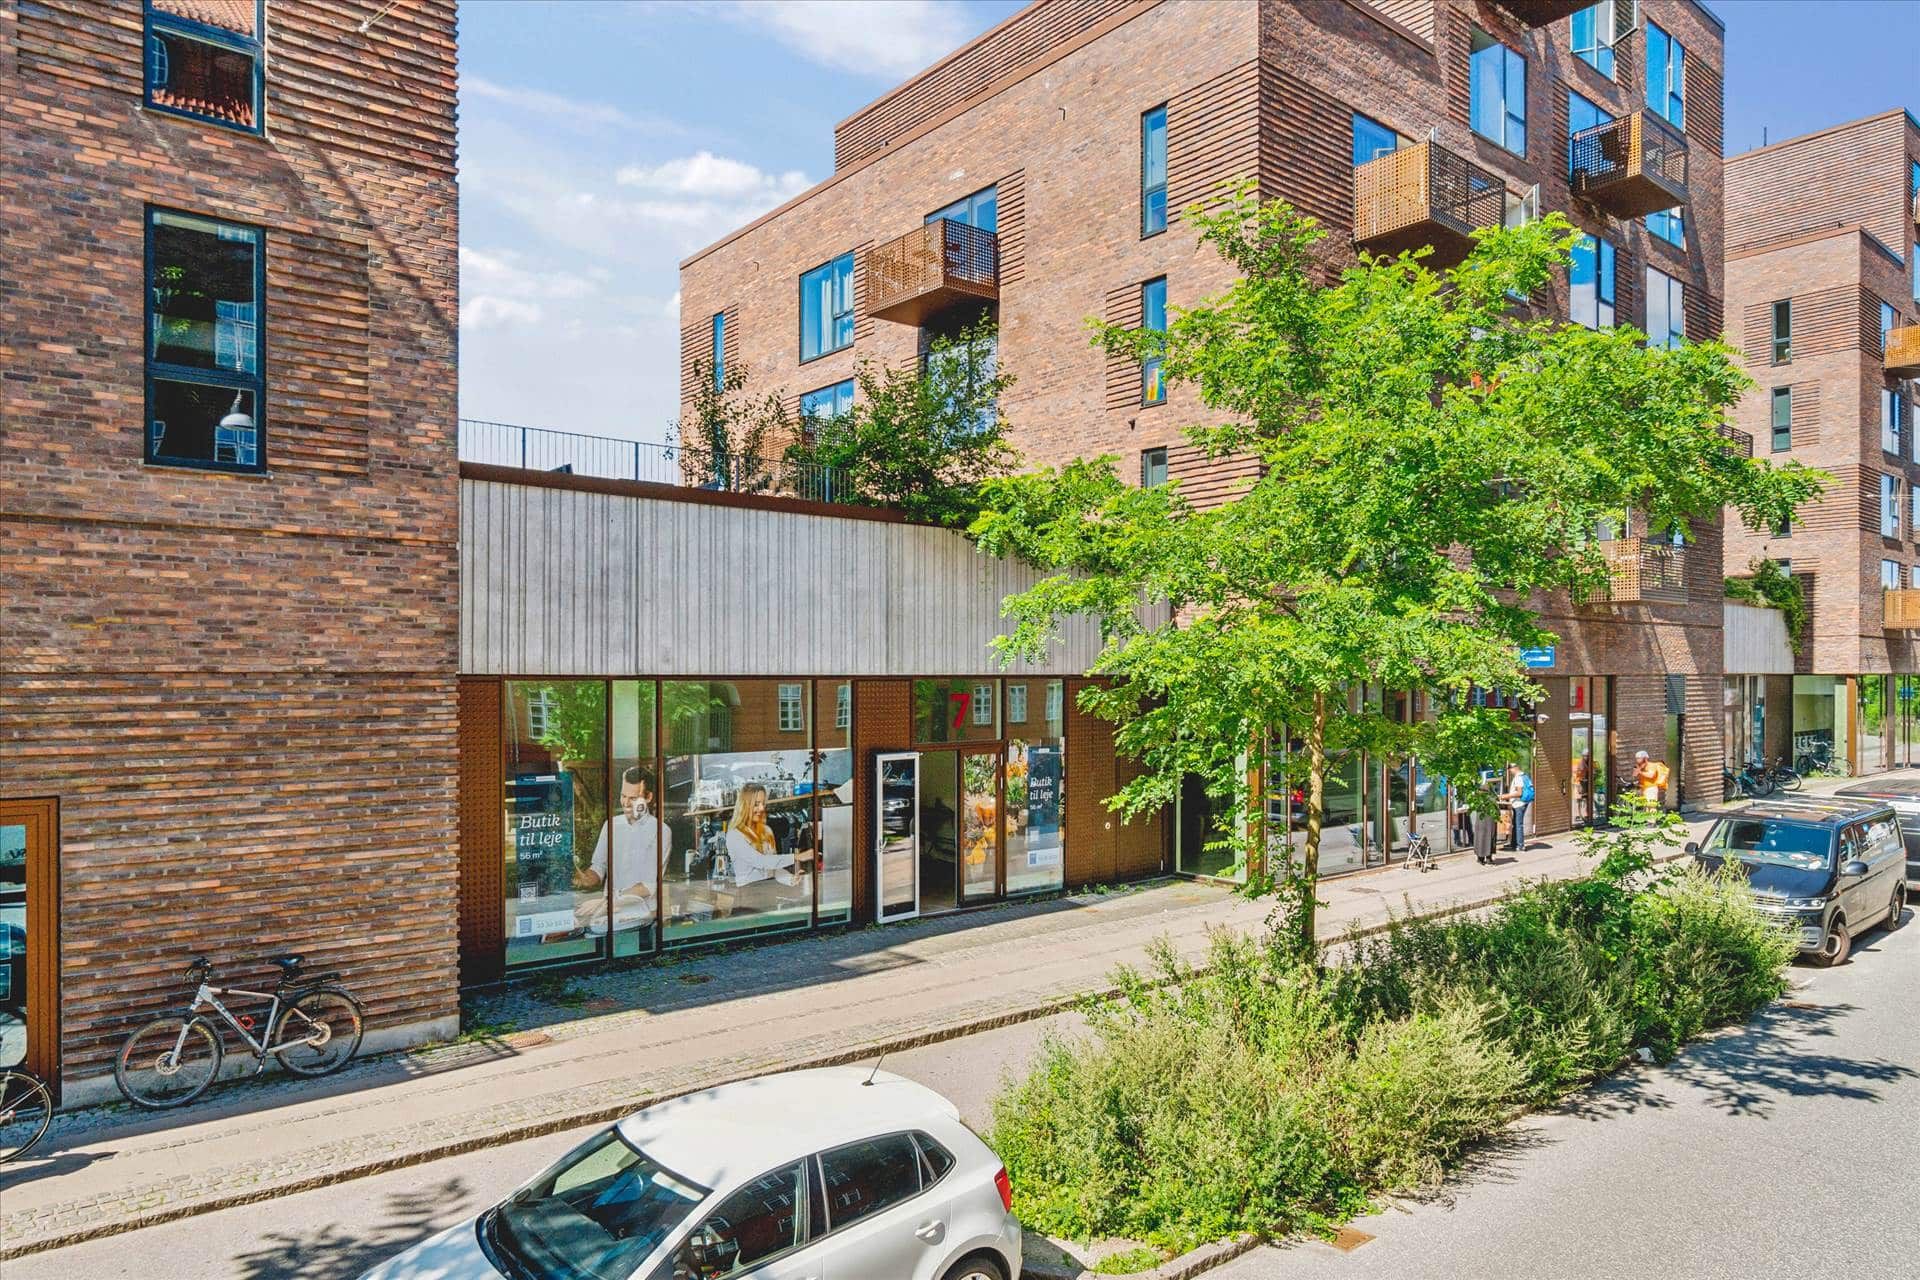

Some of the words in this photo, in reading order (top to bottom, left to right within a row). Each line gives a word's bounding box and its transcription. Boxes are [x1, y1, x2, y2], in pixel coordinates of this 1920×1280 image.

[950, 693, 971, 729] 7
[1030, 776, 1052, 788] Butik
[1030, 789, 1038, 800] til
[1040, 788, 1053, 802] leje
[520, 815, 561, 829] Butik
[519, 832, 535, 847] til
[540, 831, 562, 847] leje
